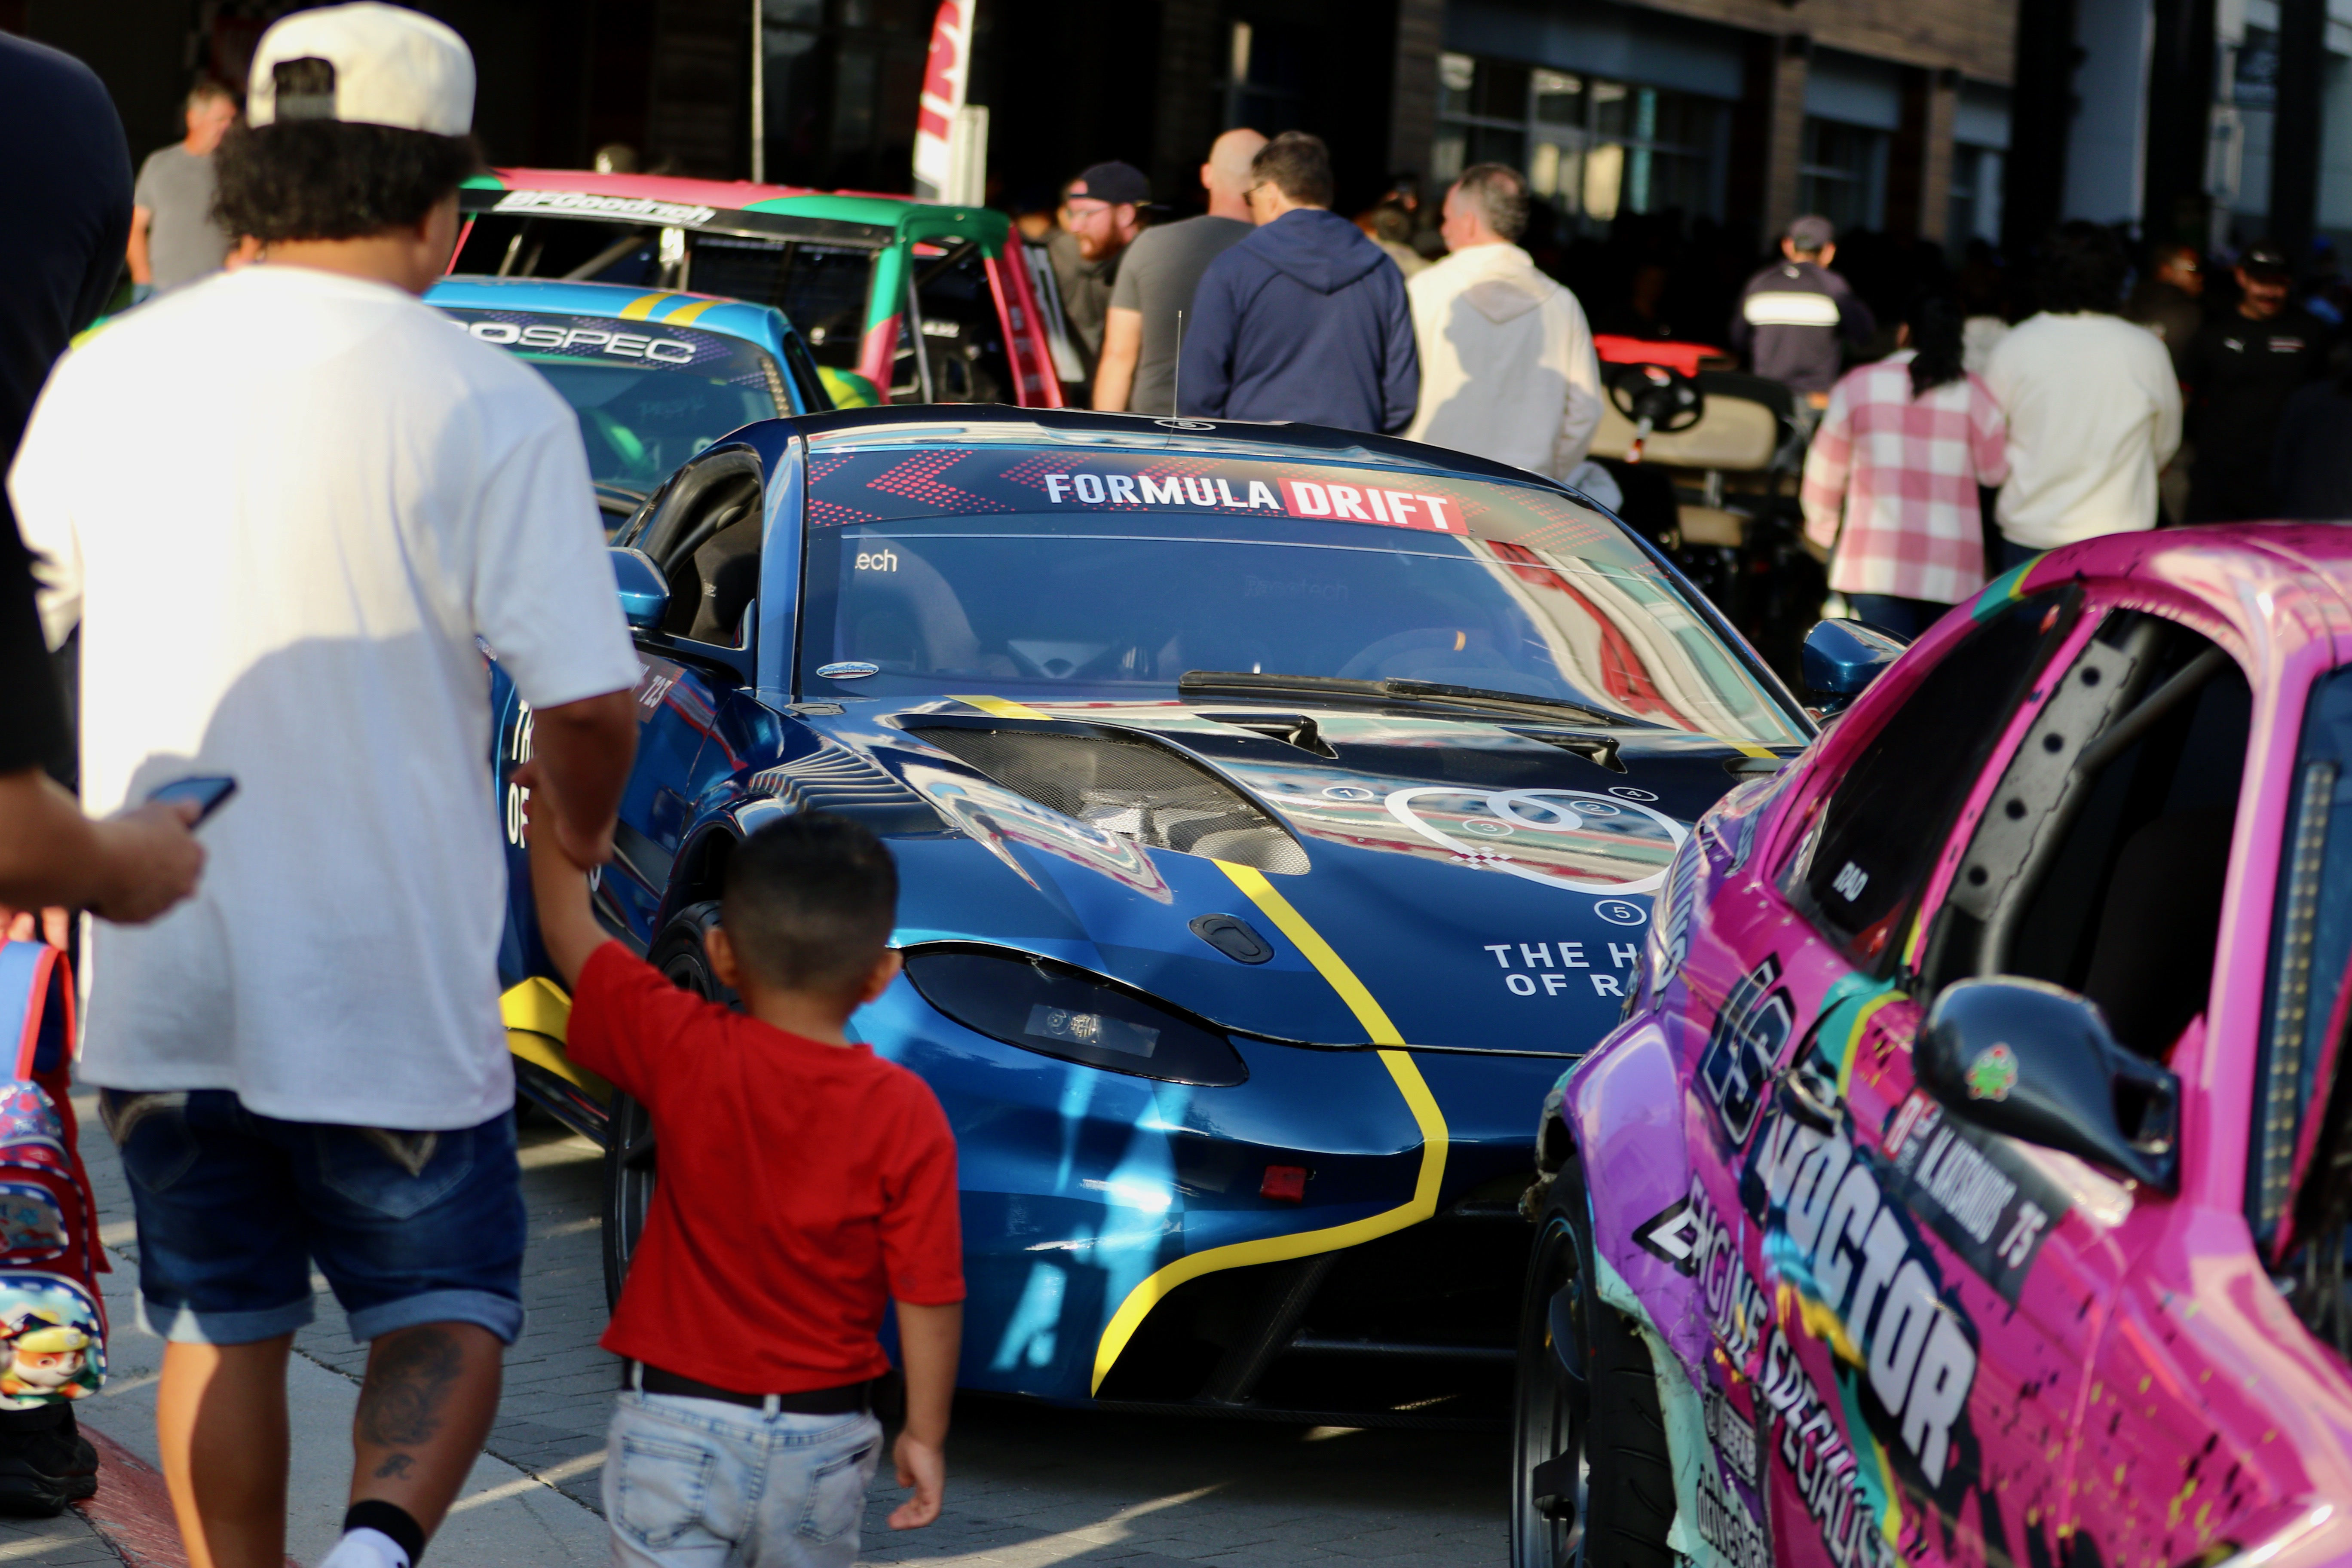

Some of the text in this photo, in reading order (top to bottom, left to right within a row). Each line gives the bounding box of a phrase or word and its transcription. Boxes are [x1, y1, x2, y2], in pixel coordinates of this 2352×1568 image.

[499, 190, 717, 224] BFGoodrich
[447, 320, 696, 364] OSPEC
[1045, 473, 1447, 530] FORMULA DRIFT
[855, 549, 897, 572] ech
[639, 675, 674, 708] 723
[1613, 906, 1630, 919] 5
[1484, 942, 1590, 968] THE
[1505, 973, 1568, 997] OF
[1997, 1200, 2049, 1269] 75
